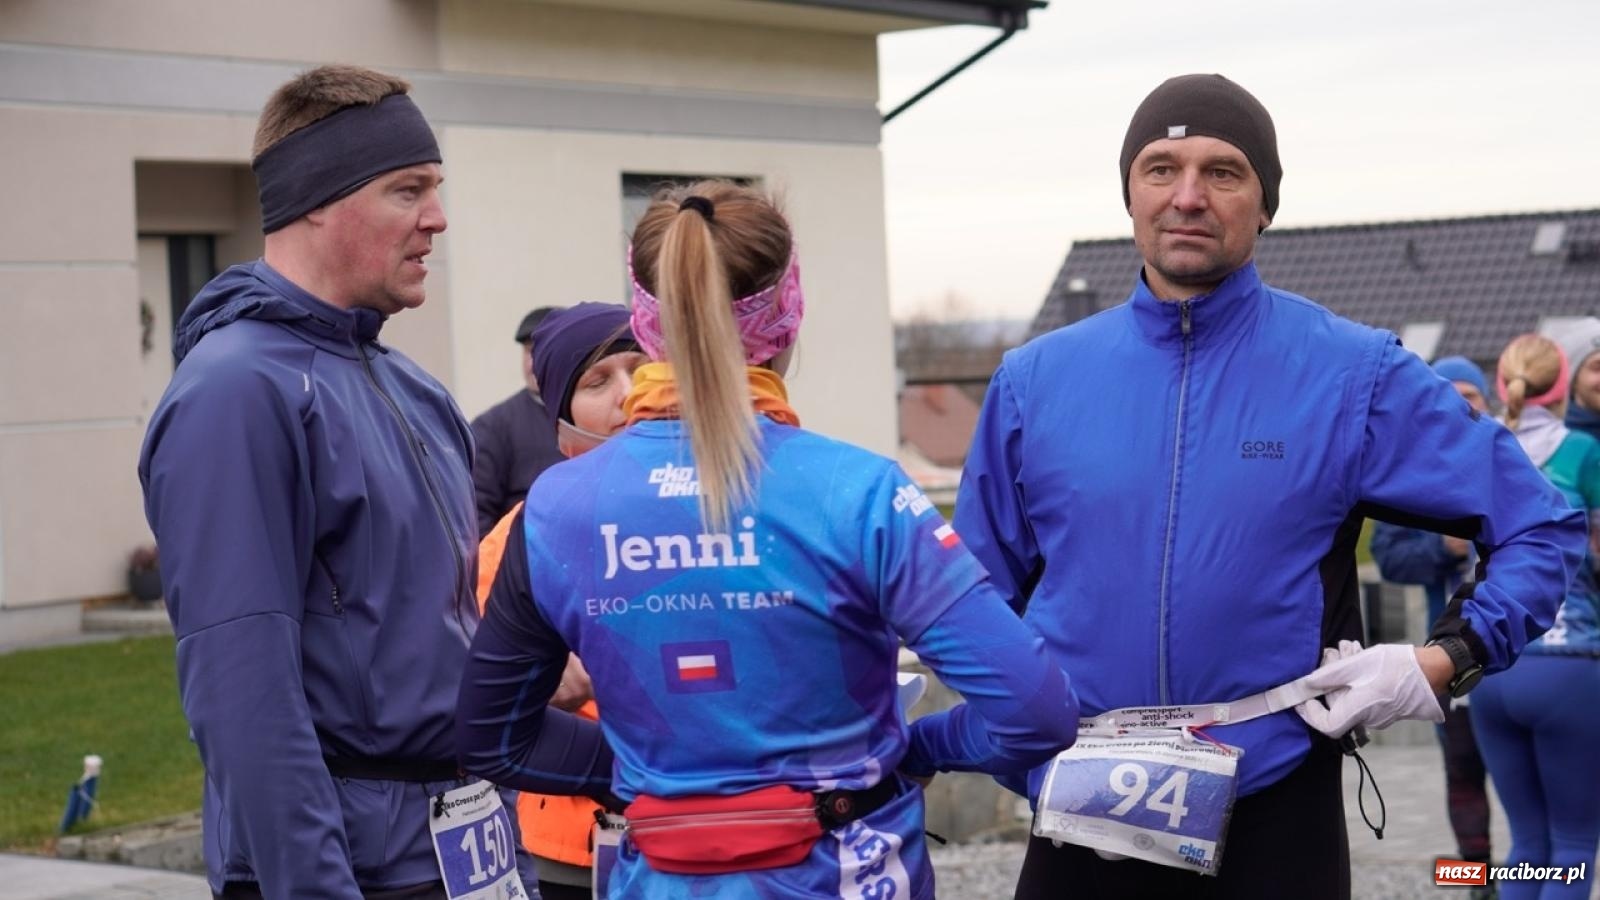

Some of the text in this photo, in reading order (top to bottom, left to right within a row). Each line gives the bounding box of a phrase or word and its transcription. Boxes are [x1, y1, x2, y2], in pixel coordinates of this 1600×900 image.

[1241, 440, 1285, 453] GORE
[600, 516, 760, 580] Jenni
[721, 590, 795, 610] TEAM
[1141, 711, 1195, 721] anti-shock
[1107, 763, 1190, 829] 94
[460, 815, 509, 886] 150
